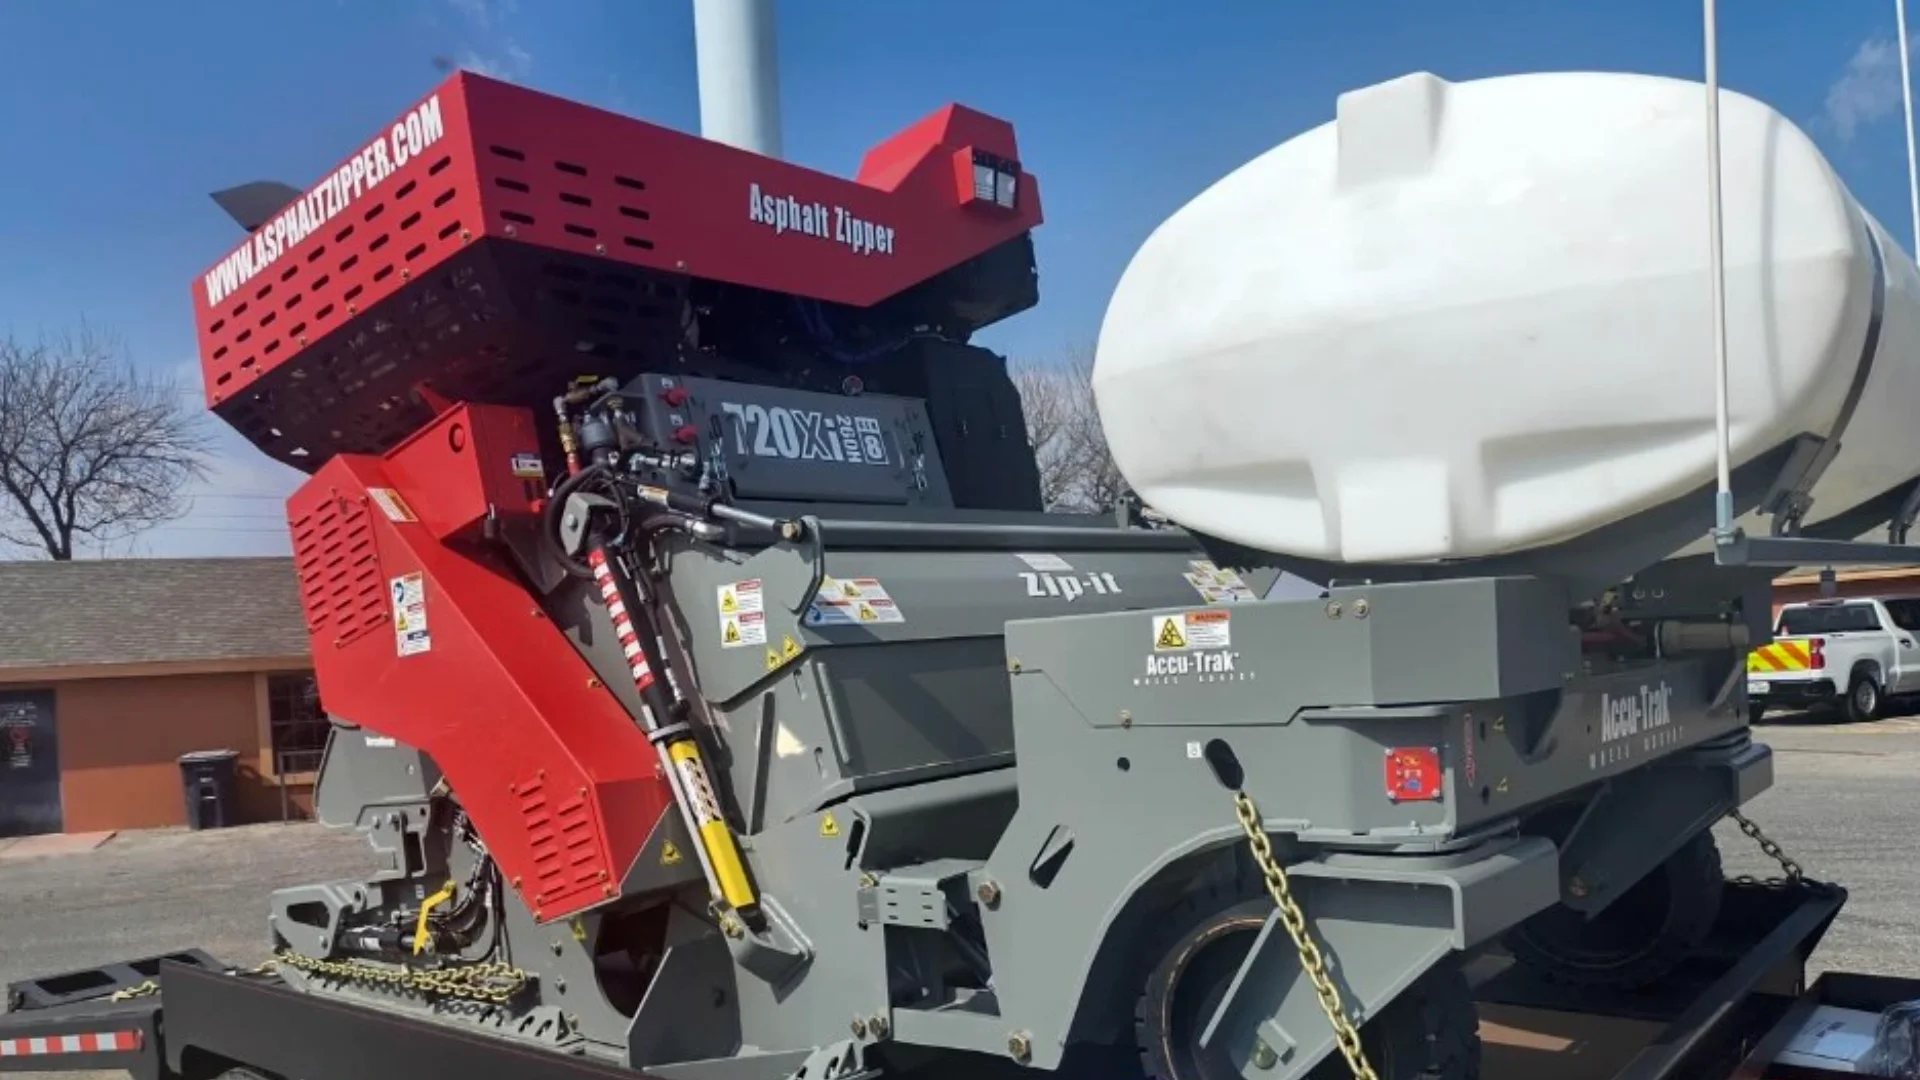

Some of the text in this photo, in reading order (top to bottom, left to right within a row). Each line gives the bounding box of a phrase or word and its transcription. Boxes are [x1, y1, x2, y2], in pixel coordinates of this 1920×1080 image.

[205, 94, 443, 308] WWW.ASPHALTZIPPER.COM
[750, 182, 895, 256] Asphalt Zipper
[721, 402, 844, 462] 720Xi
[1018, 571, 1122, 602] Zip-it
